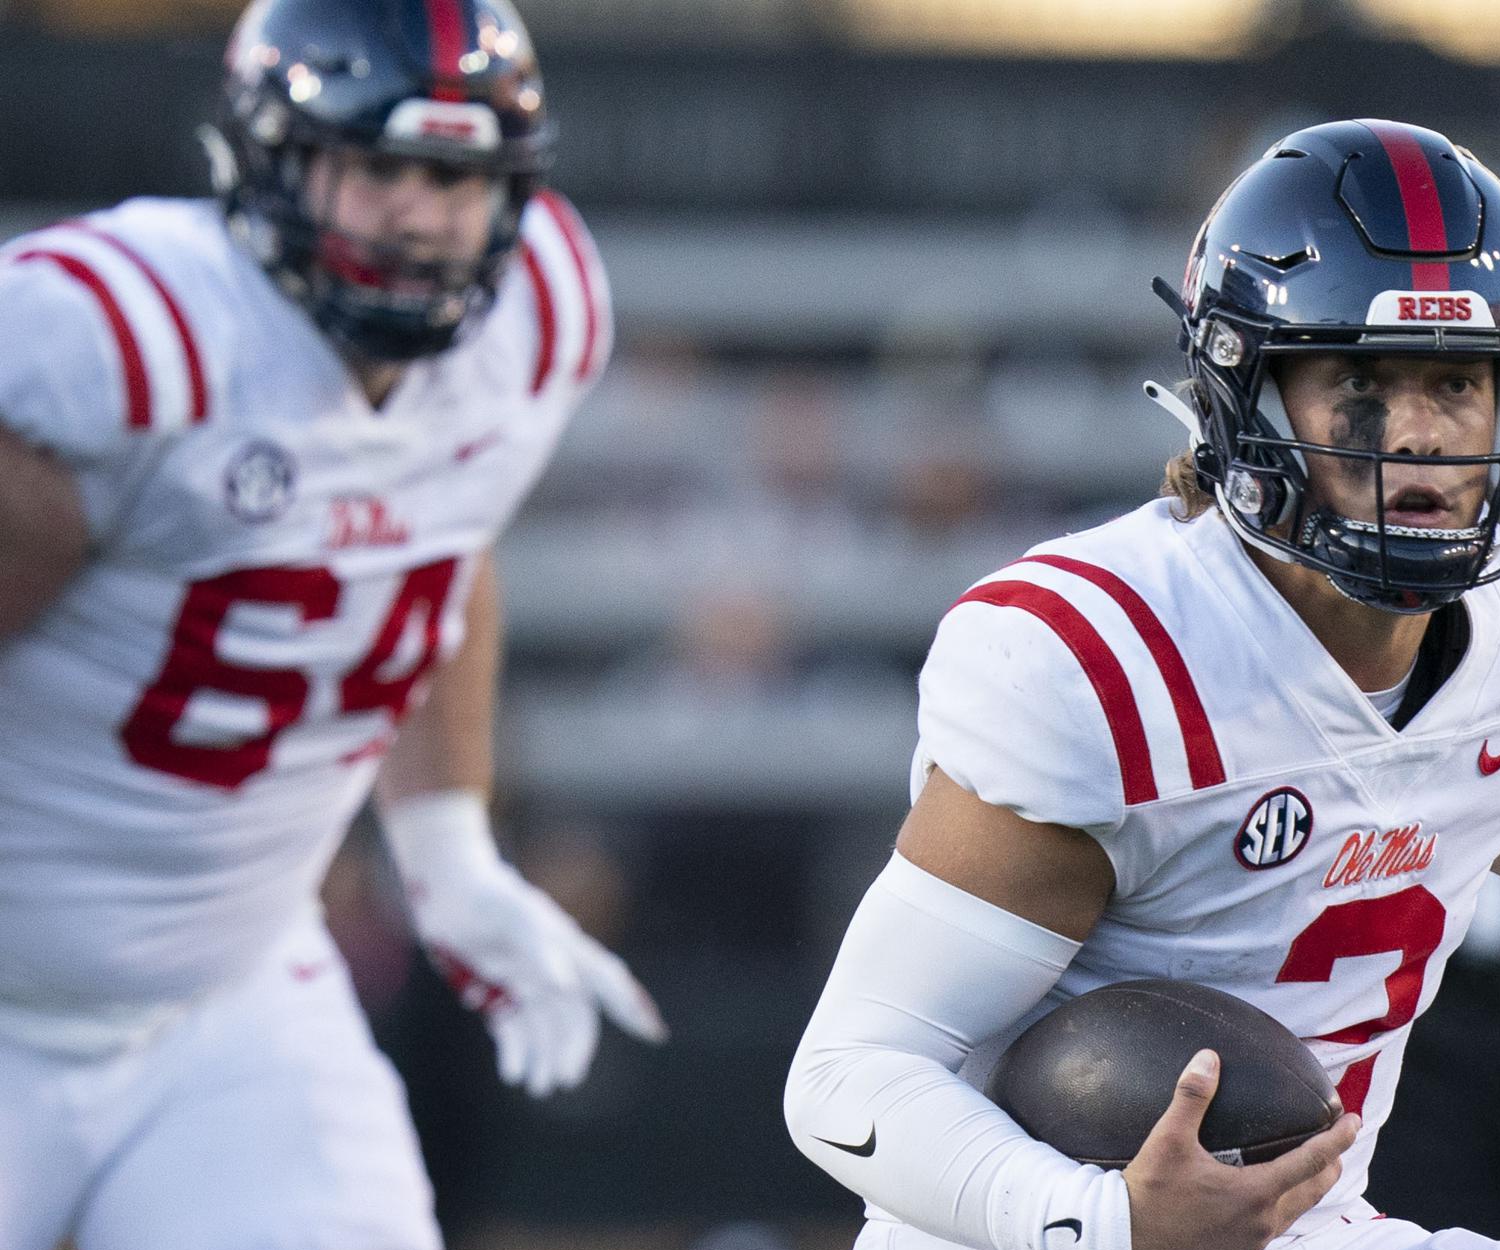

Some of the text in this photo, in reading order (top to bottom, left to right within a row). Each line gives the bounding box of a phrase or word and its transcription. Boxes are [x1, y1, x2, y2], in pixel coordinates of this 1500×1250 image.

[1397, 296, 1473, 322] REBS
[119, 554, 460, 794] 64
[1241, 793, 1308, 866] SEC
[1322, 821, 1439, 889] Ole Miss
[1274, 883, 1447, 1128] 2
